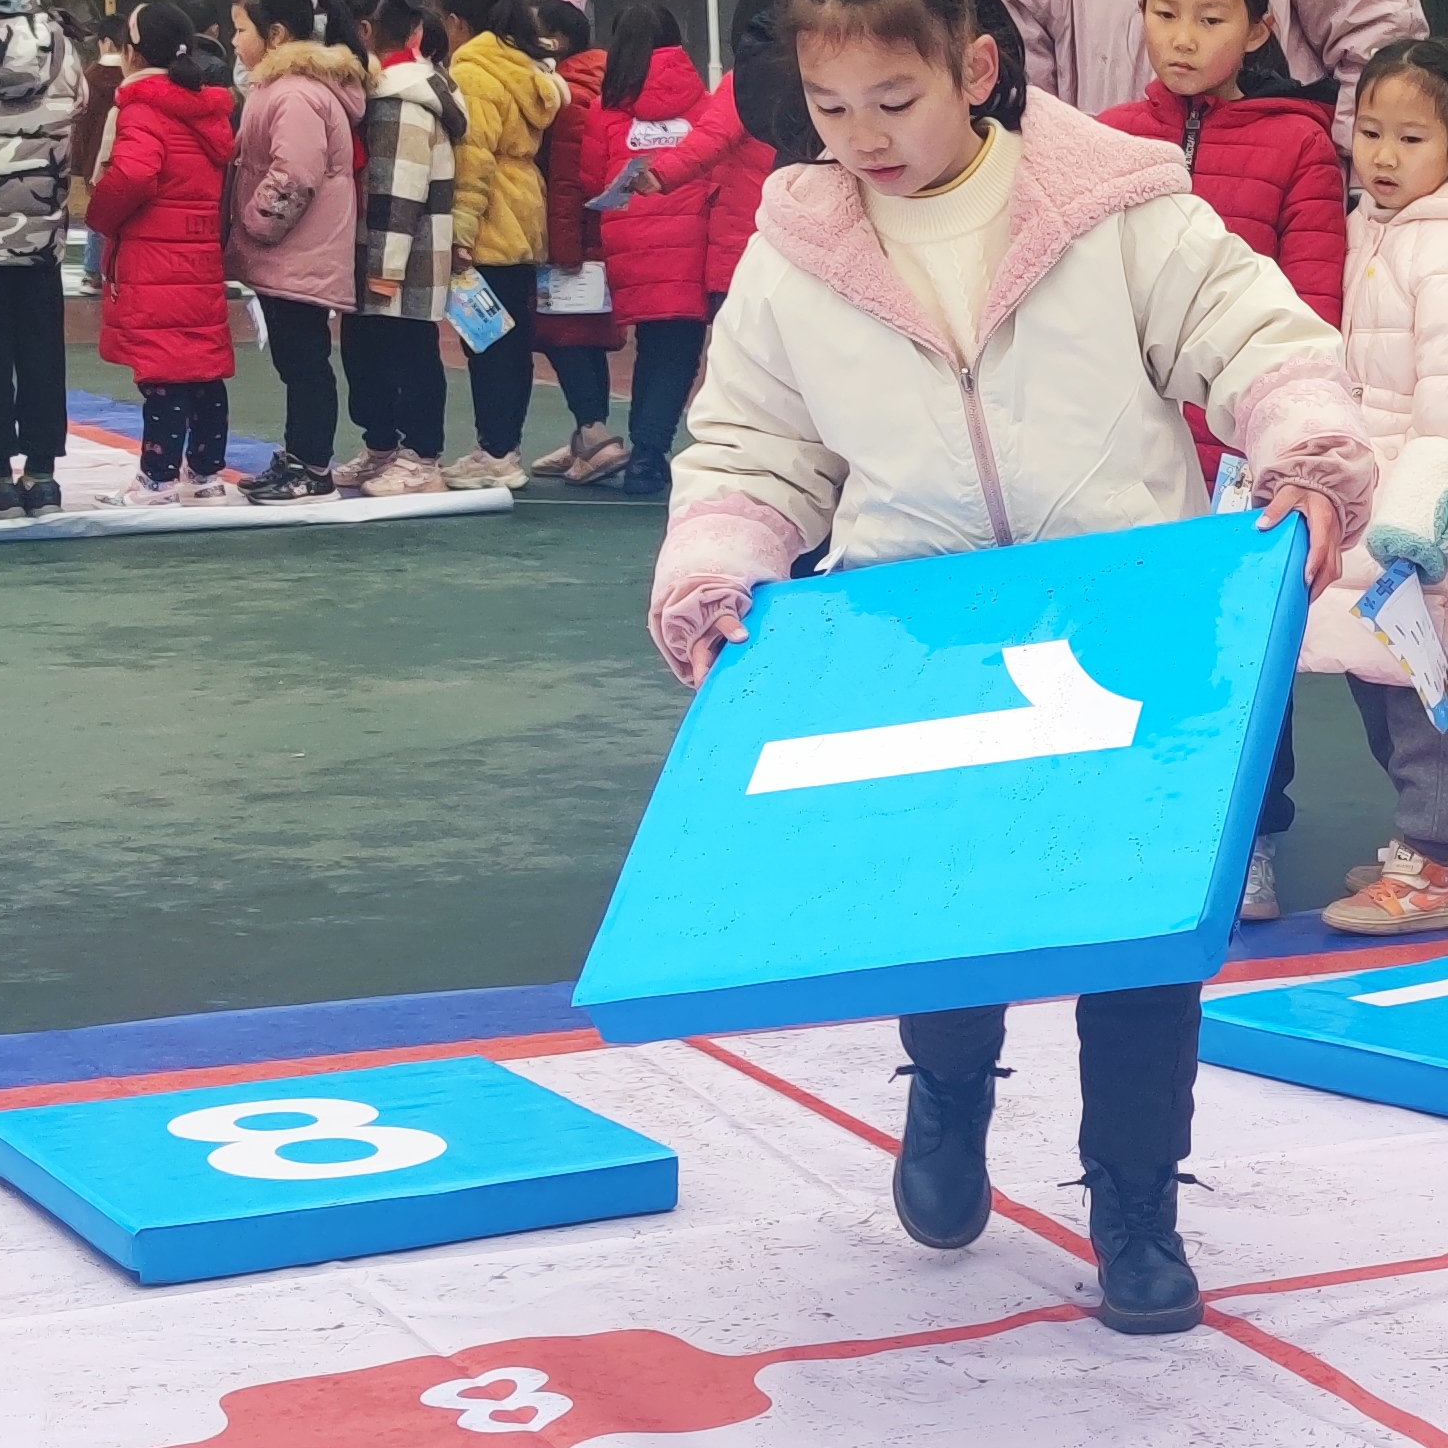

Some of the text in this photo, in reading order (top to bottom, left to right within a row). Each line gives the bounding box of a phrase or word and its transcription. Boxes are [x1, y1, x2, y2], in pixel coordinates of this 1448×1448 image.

[745, 638, 1143, 795] 1
[166, 1097, 448, 1181] 8
[418, 1365, 575, 1436] 8
